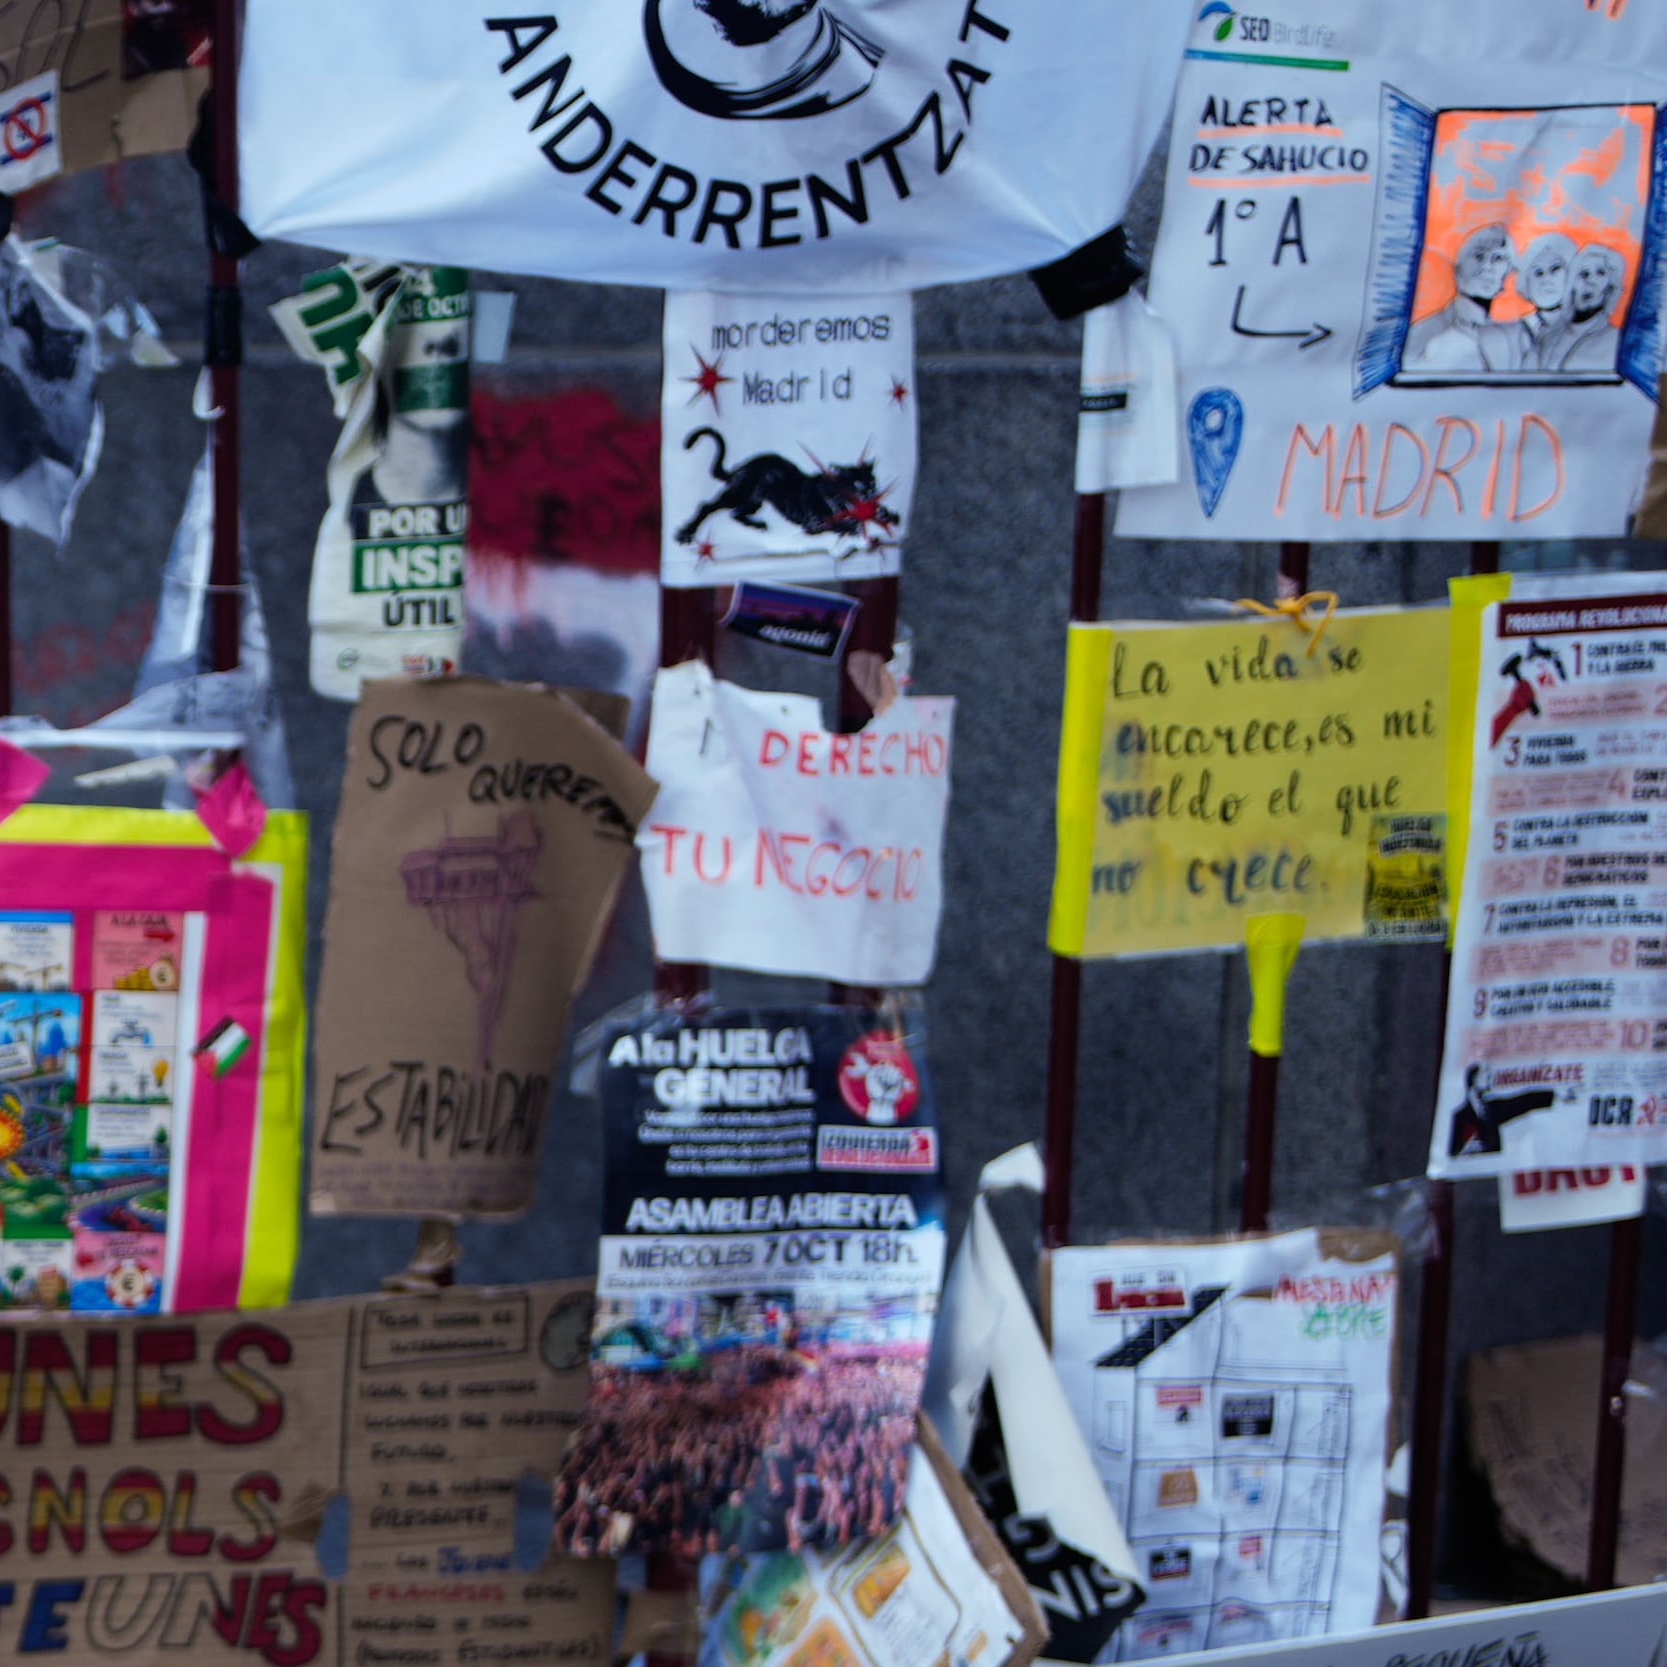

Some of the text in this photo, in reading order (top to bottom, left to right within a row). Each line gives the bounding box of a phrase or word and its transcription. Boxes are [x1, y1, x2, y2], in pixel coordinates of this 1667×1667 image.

[1199, 95, 1335, 128] ALERTA
[1188, 144, 1369, 172] DESAHUCIO
[1273, 196, 1308, 267] A
[712, 313, 893, 353] morderemos
[740, 369, 854, 407] Madrid
[1274, 413, 1567, 523] MADRID
[370, 507, 437, 537] POR
[383, 592, 457, 629] ÚTIL
[1112, 636, 1363, 699] La vida se
[1571, 642, 1582, 677] 1
[1384, 699, 1437, 741] mi
[366, 715, 484, 790] SOLO
[757, 729, 948, 777] DERECHO
[1505, 736, 1521, 767] 3
[1101, 770, 1403, 836] sueldo el que
[1493, 821, 1509, 853] 5
[649, 823, 924, 902] TU NEGOCIO
[1092, 858, 1140, 896] no
[1543, 855, 1562, 888] 6
[1610, 937, 1629, 967] 8
[1473, 988, 1488, 1018] 9
[608, 1031, 638, 1067] A
[678, 1027, 814, 1066] HUELGA
[1619, 1019, 1649, 1050] 10
[655, 1068, 815, 1109] GENERAL
[625, 1194, 919, 1231] ASAMBLEA ABIERTA
[619, 1238, 755, 1268] MIÉRCOLES
[763, 1236, 780, 1265] 7
[783, 1235, 847, 1264] OCT
